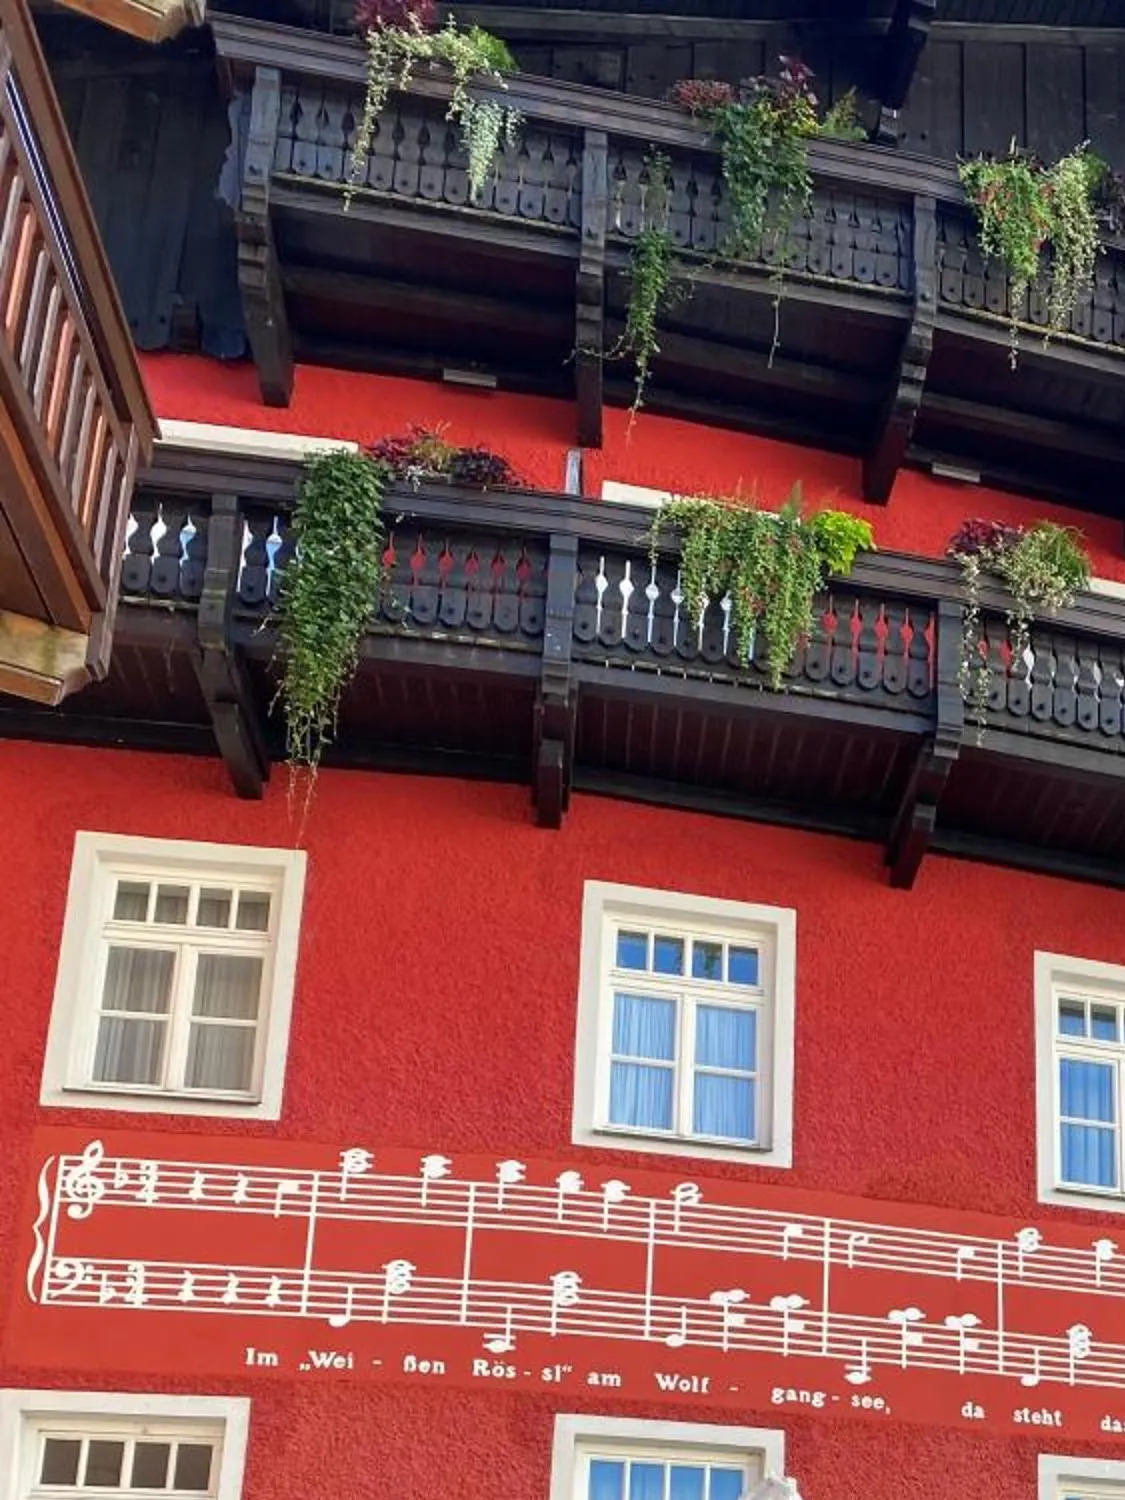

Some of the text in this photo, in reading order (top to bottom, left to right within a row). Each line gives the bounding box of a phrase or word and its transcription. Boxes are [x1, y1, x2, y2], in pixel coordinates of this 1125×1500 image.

[245, 1347, 279, 1367] Im
[472, 1358, 517, 1379] Rös
[586, 1371, 622, 1387] am
[654, 1372, 710, 1394] Wolf
[770, 1387, 827, 1409] gang
[851, 1394, 891, 1415] see,
[960, 1401, 986, 1419] da
[1013, 1407, 1063, 1427] steht
